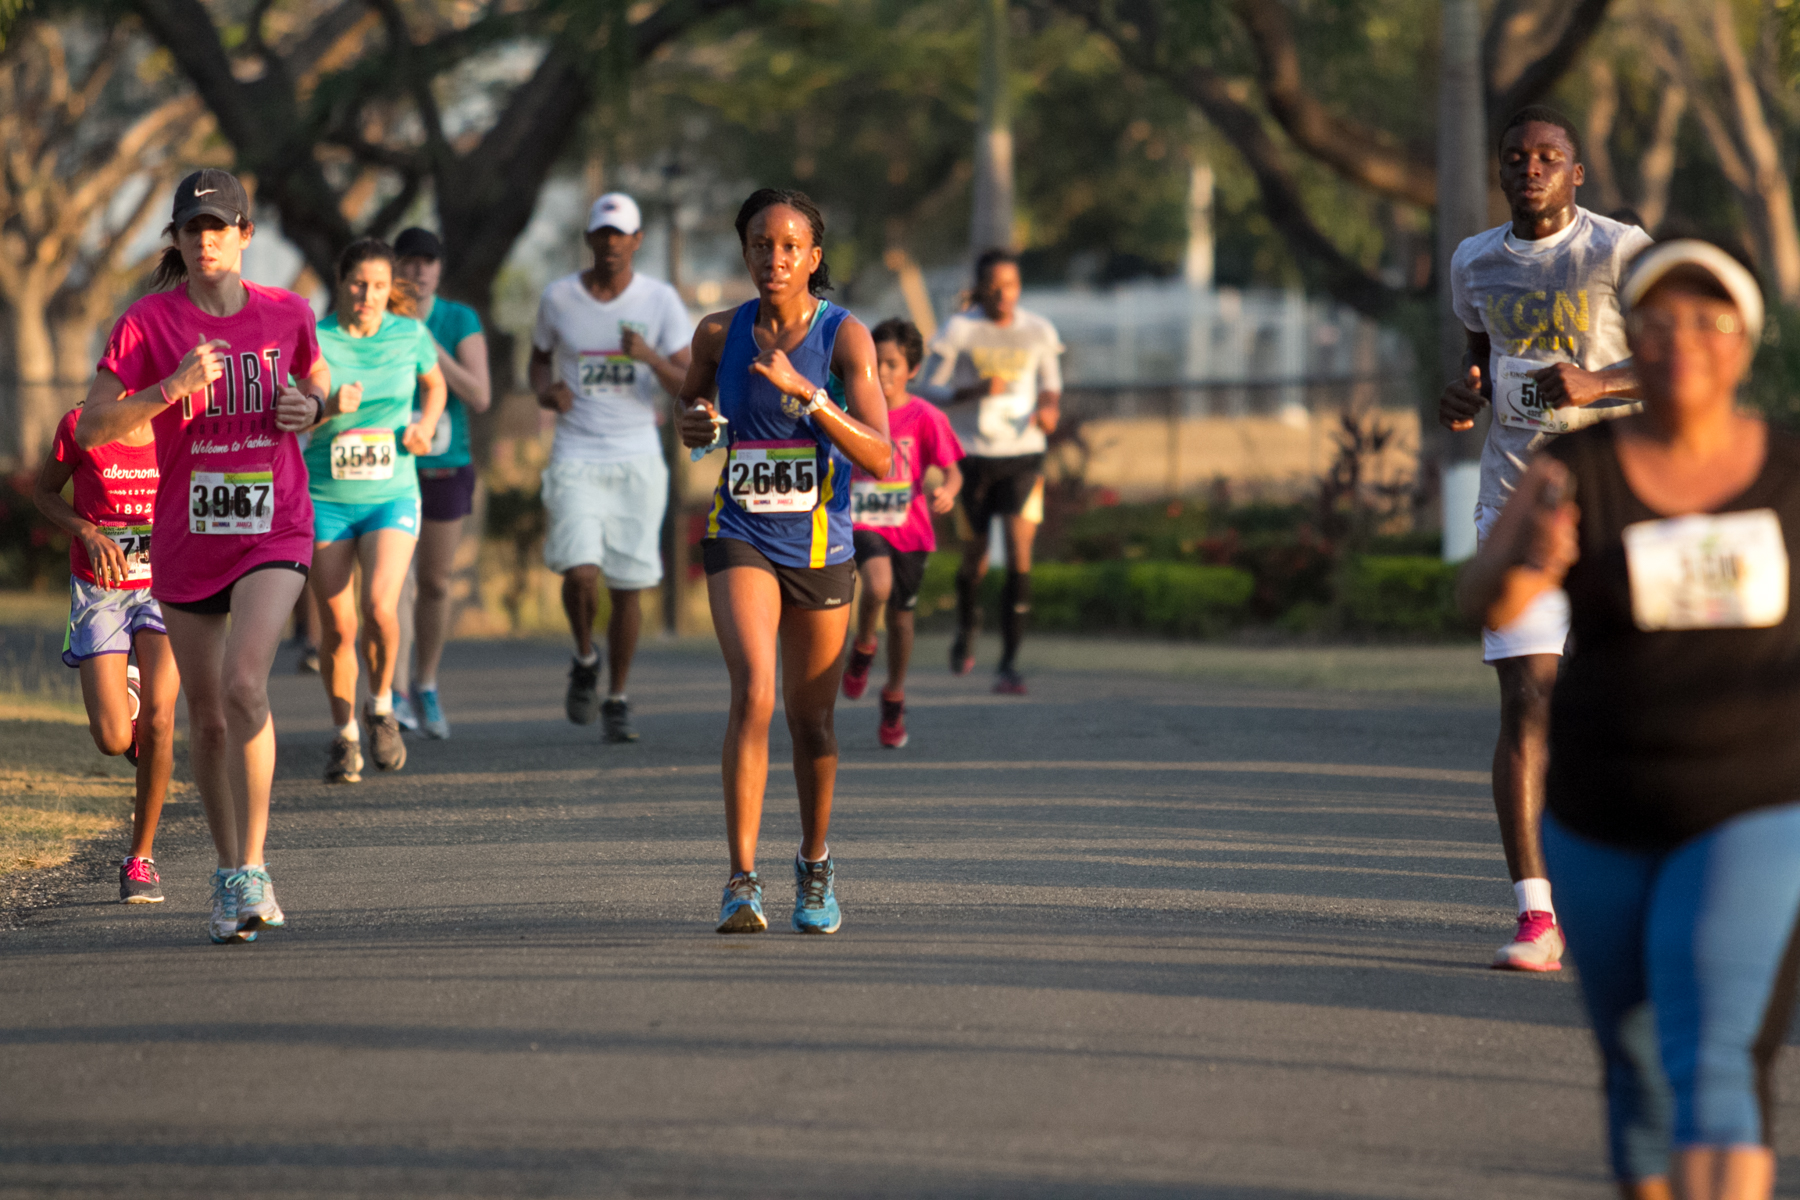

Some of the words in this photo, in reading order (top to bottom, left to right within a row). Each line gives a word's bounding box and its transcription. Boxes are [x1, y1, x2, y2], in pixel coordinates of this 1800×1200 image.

[1486, 289, 1590, 335] KGN
[191, 439, 230, 455] Welcome
[231, 441, 241, 453] to
[334, 445, 392, 468] 3558
[732, 461, 814, 496] 2665
[115, 502, 152, 515] 1892
[192, 485, 270, 518] 3967
